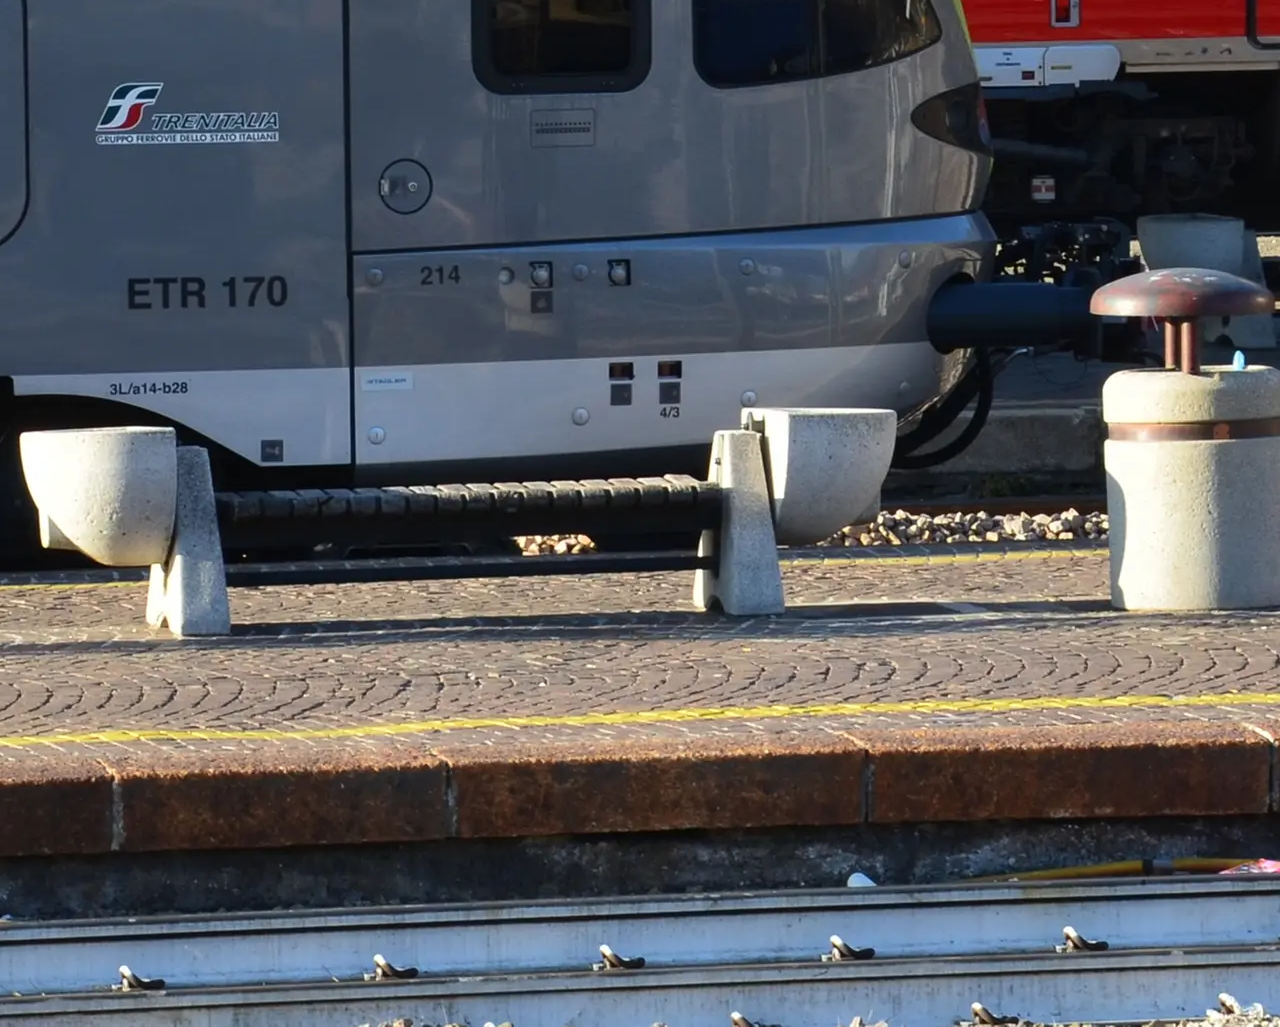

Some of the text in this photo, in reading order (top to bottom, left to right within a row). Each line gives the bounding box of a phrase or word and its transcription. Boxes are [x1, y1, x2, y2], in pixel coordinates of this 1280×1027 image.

[152, 112, 280, 131] TRENITALIA
[97, 132, 278, 143] GRUPPO FERROVIE DELLO STATO ITALIANE
[420, 264, 461, 286] 214
[127, 275, 288, 310] ETR 170
[109, 382, 189, 396] 3L/a14-b28
[660, 406, 680, 418] 4/3
